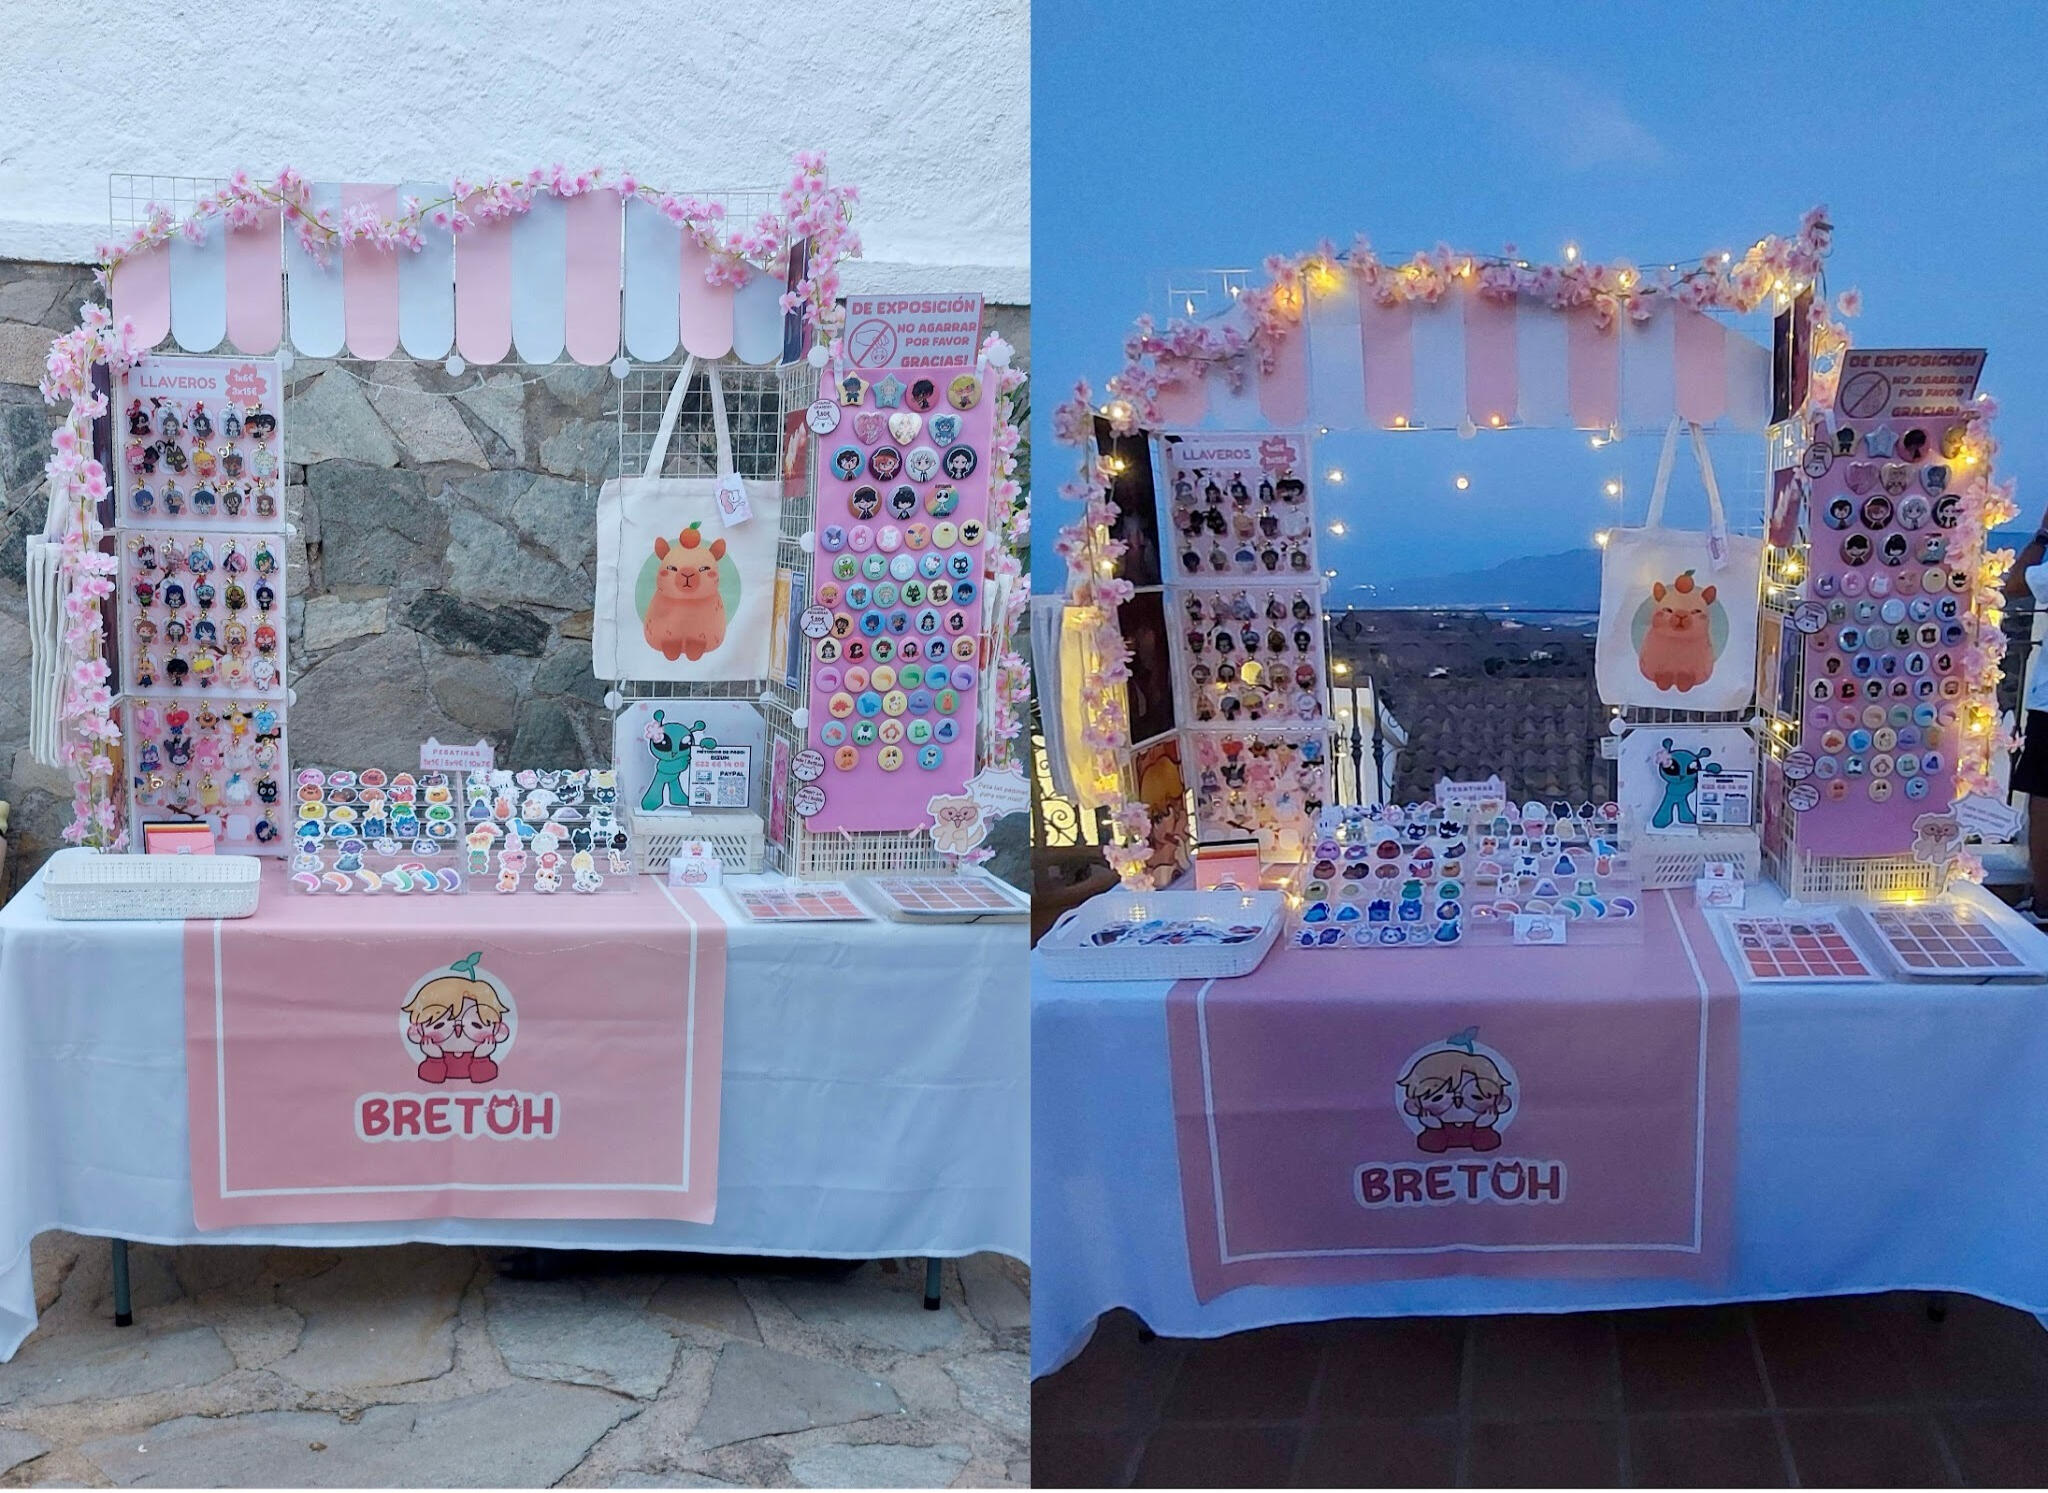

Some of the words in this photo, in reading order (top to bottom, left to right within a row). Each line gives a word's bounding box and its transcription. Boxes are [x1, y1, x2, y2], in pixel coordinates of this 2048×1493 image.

[852, 302, 872, 315] DE
[877, 296, 975, 314] EXPOSICIÓN
[897, 323, 915, 333] NO
[918, 321, 977, 333] AGARRAR
[905, 337, 930, 347] POR
[933, 336, 969, 346] FAVOR
[901, 354, 969, 367] GRACIAS!
[1850, 355, 1871, 368] DE
[1874, 352, 1978, 367] EXPOSICIÓN
[140, 375, 217, 390] LLAVEROS
[1892, 375, 1911, 385] NO
[1914, 375, 1974, 385] AGARRAR
[1899, 388, 1923, 397] POR
[1926, 388, 1964, 397] FAVOR
[1183, 449, 1251, 461] LLAVEROS
[362, 1094, 554, 1136] BRETOH
[1361, 1161, 1561, 1203] BRETOH
